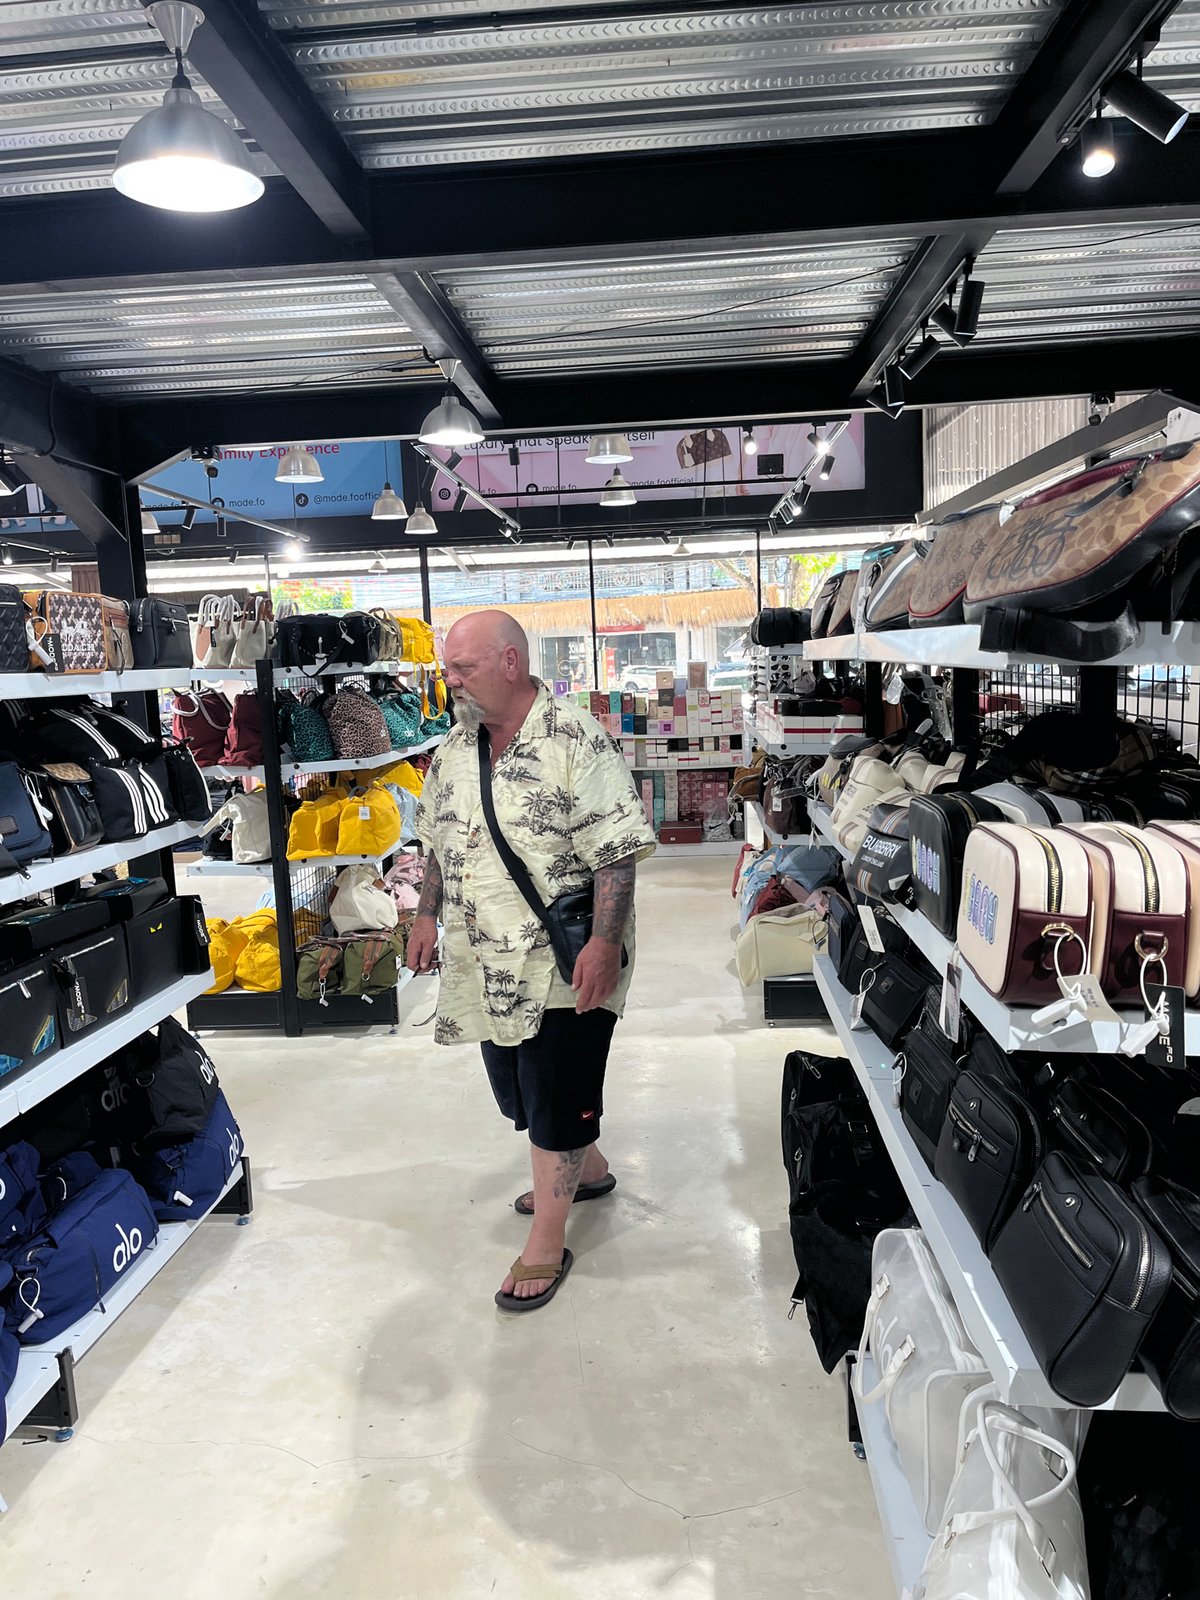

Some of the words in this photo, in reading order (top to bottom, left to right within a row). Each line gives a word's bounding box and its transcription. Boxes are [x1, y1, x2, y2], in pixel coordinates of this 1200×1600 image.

[518, 437, 541, 448] hat
[624, 431, 655, 442] tself
[260, 444, 340, 459] Expence
[229, 497, 265, 508] mode.fo
[226, 1127, 240, 1168] alo
[113, 1223, 142, 1273] alo
